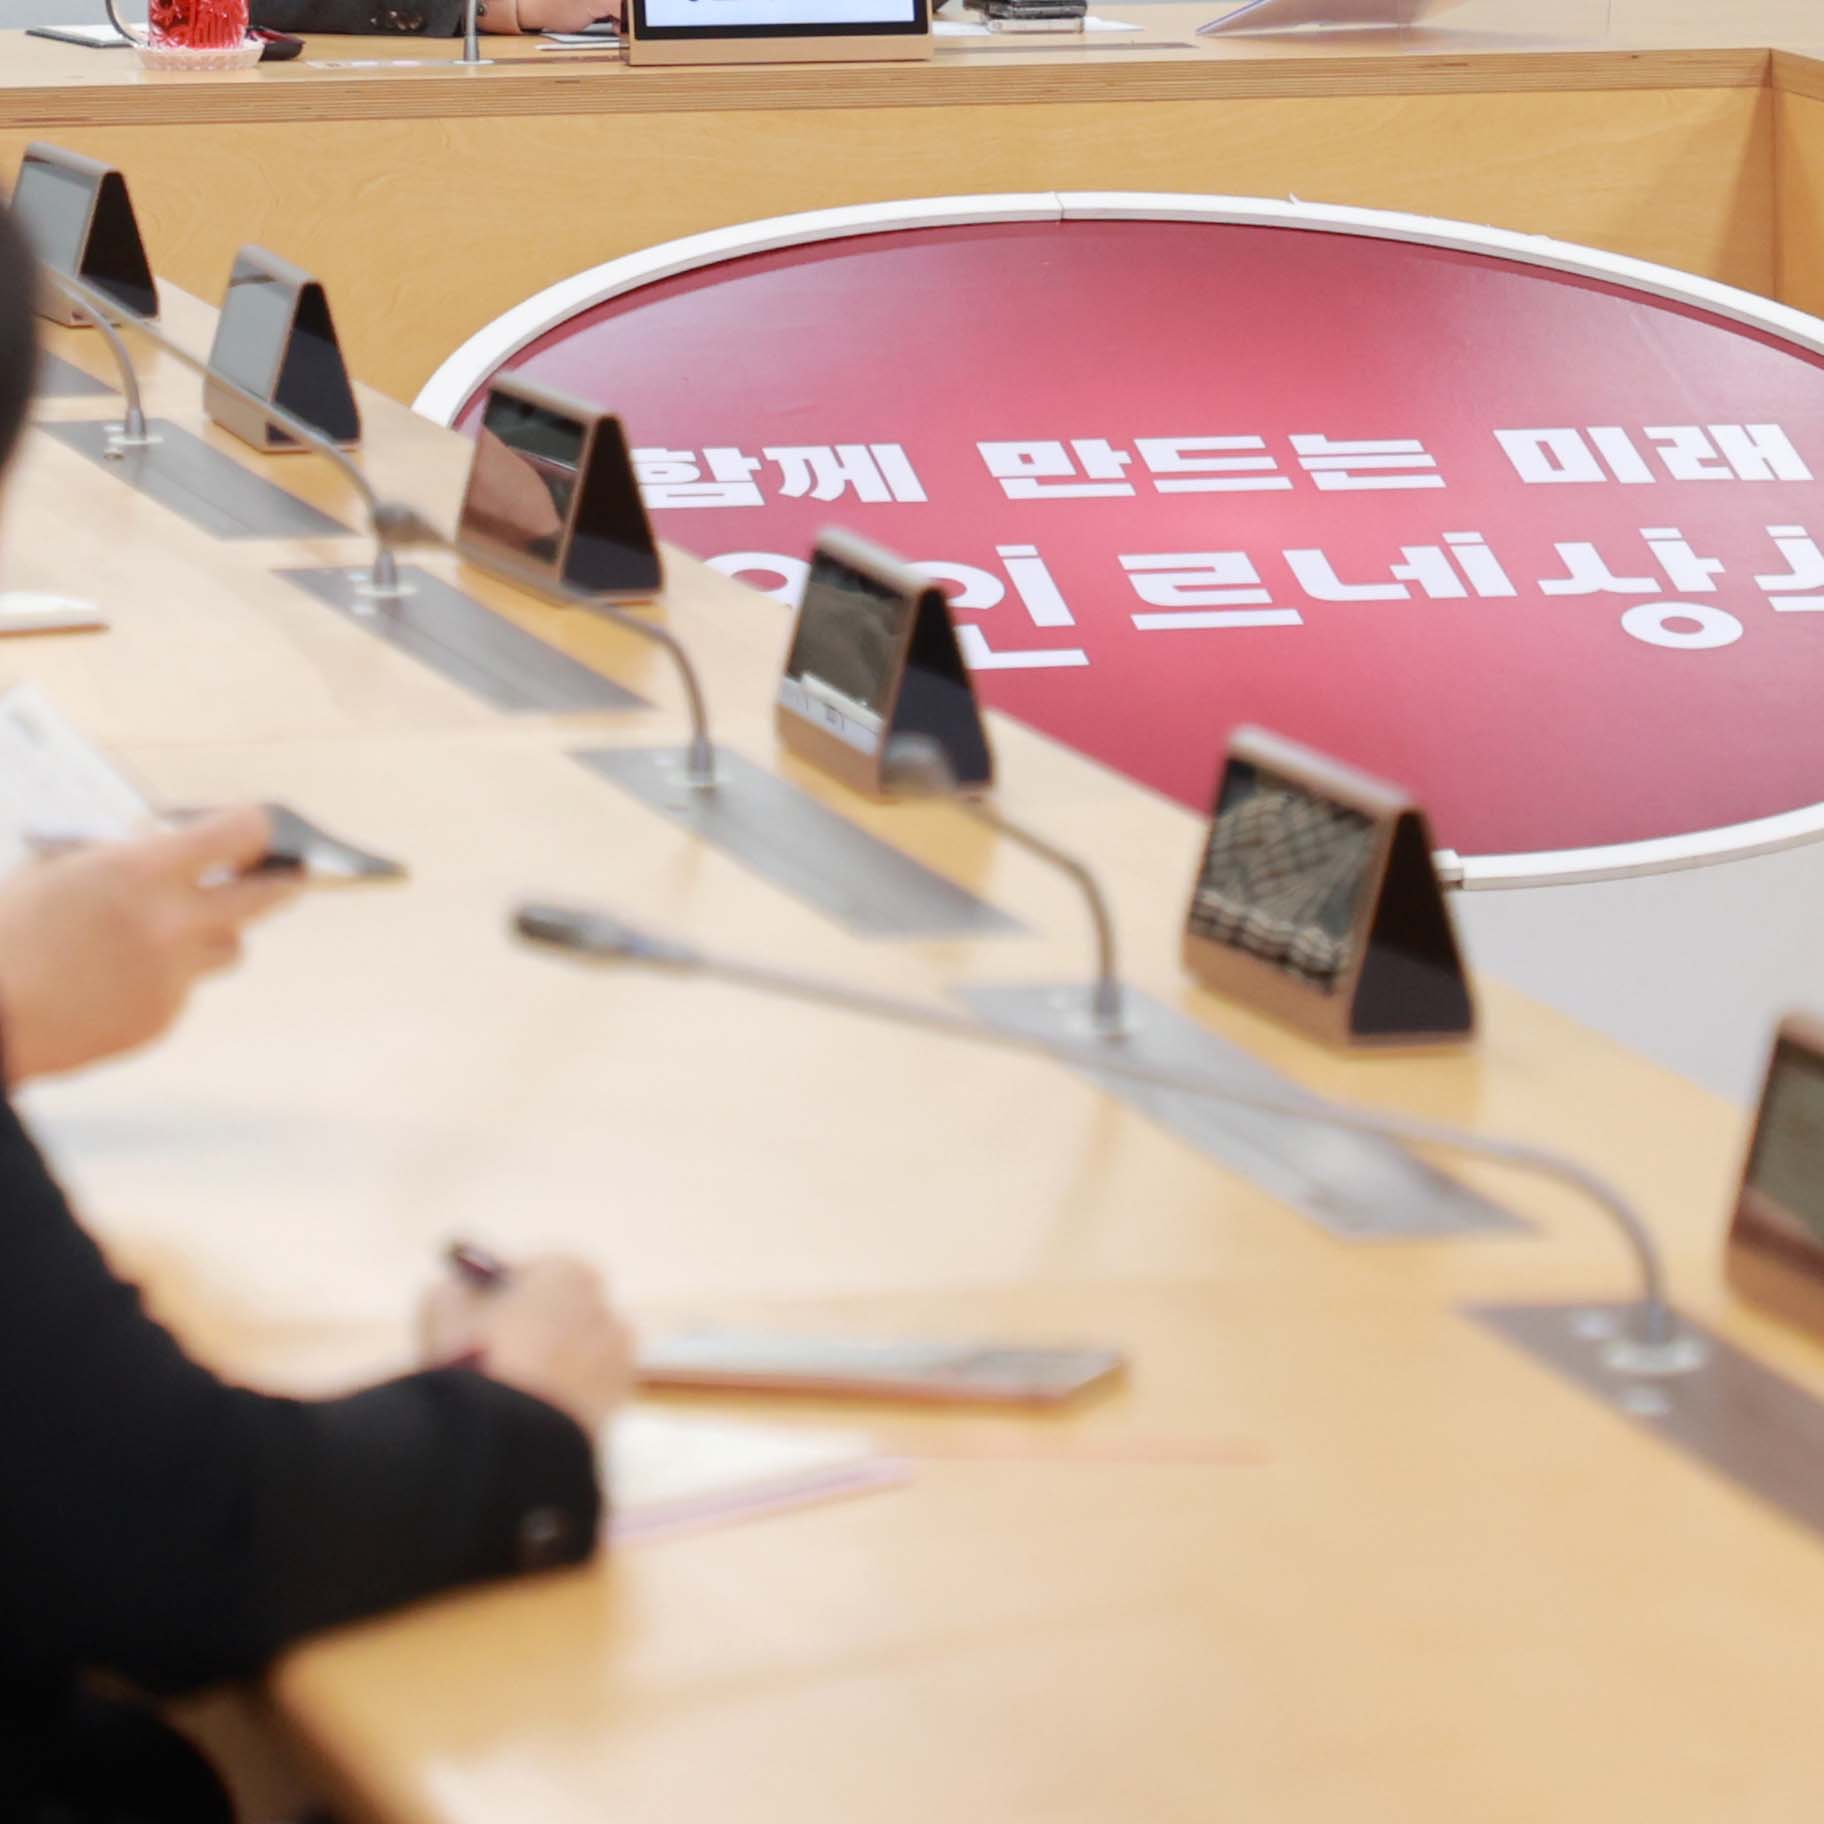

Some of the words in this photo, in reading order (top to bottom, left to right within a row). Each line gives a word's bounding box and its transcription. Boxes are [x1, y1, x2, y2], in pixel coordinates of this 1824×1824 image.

[631, 442, 929, 510] 함께
[976, 433, 1447, 500] 만드는
[1492, 423, 1815, 484] 미래
[703, 543, 1091, 671] 인
